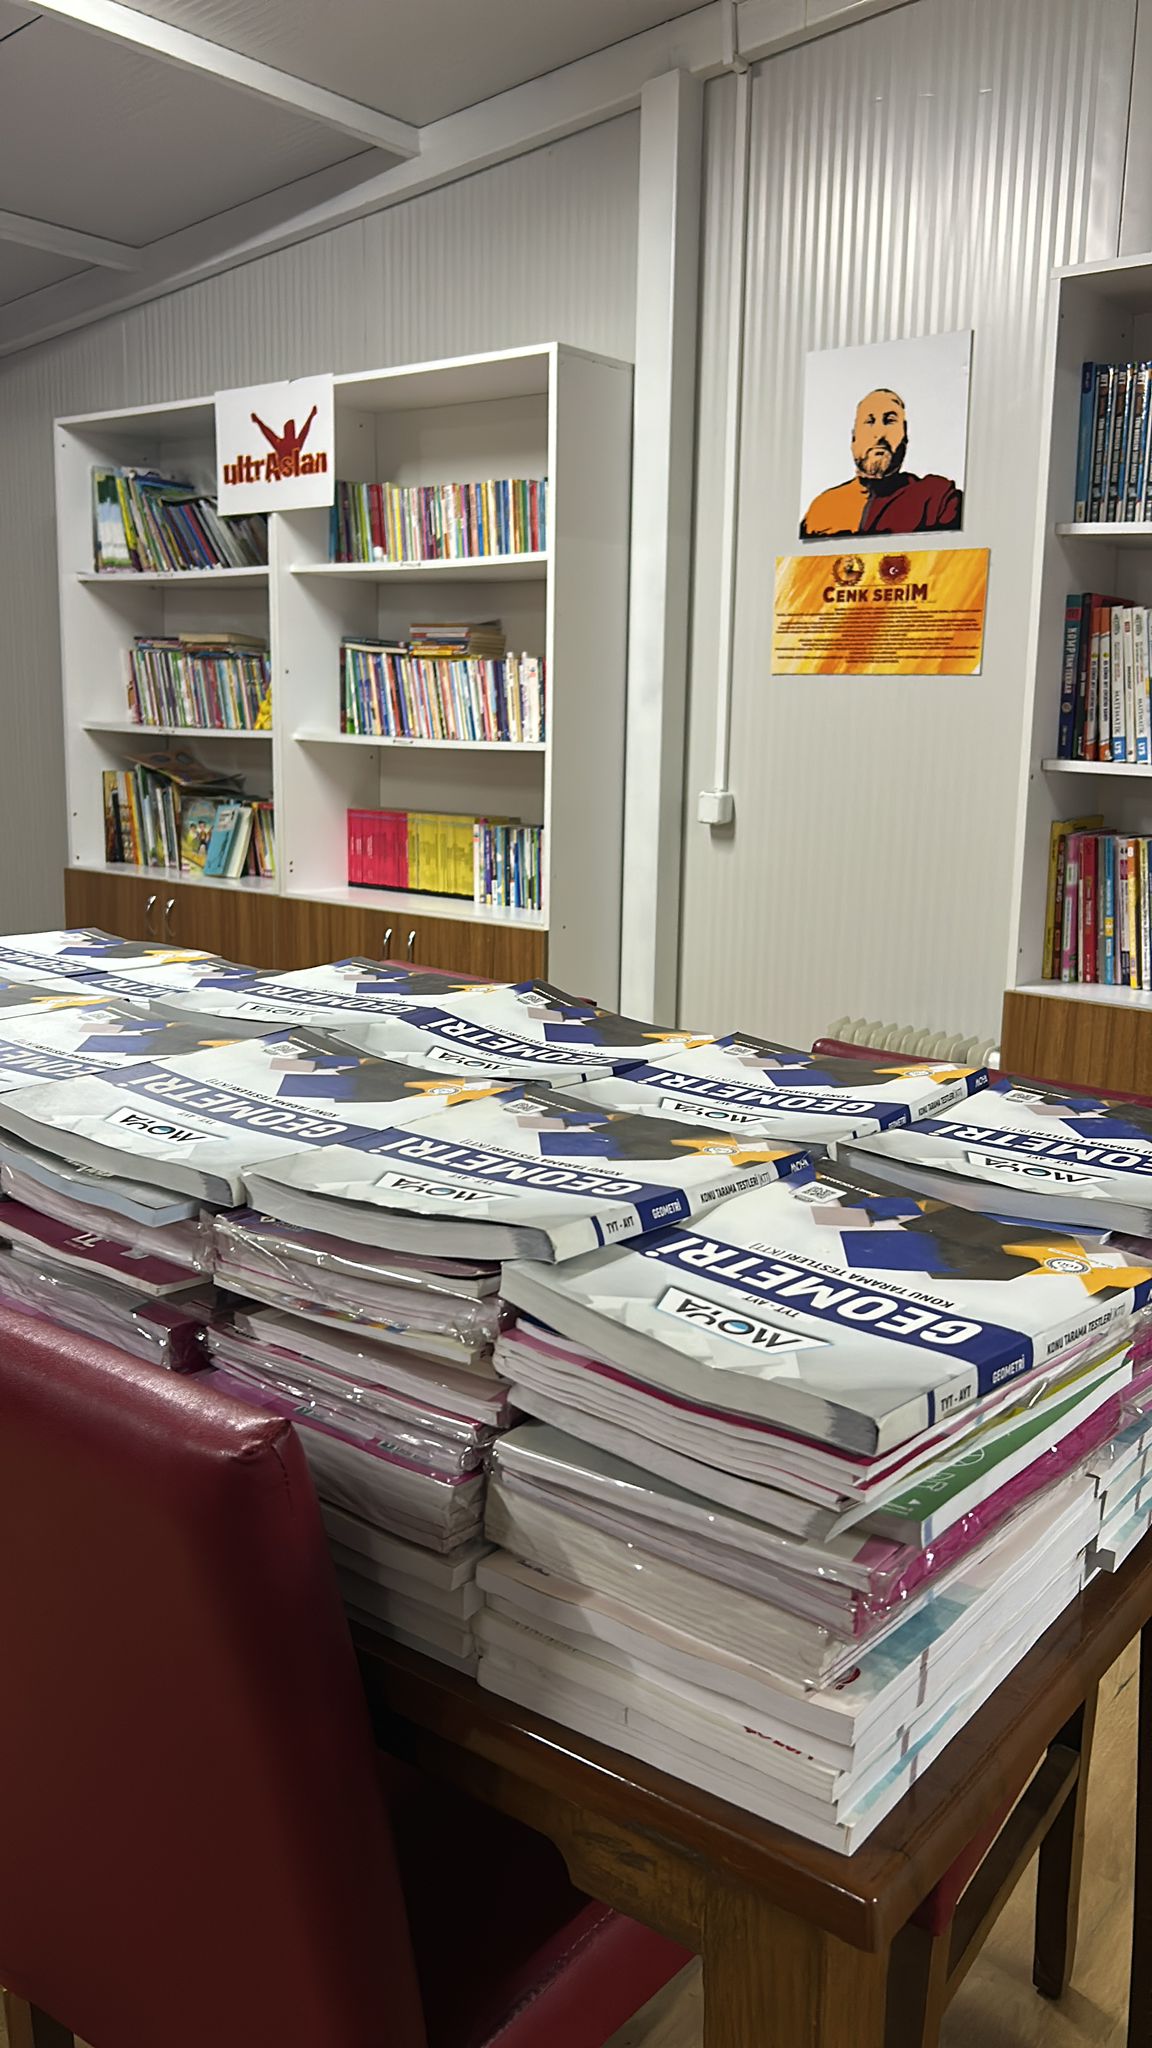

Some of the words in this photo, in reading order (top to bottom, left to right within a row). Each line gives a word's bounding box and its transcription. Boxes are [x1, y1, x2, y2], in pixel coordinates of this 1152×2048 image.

[223, 448, 327, 485] ultrAslan
[822, 586, 868, 603] CENK
[419, 1017, 619, 1065] GEOMETRİ
[115, 1073, 349, 1138] GEOMETRİ
[637, 1072, 876, 1114] GEOMETRİ
[673, 1103, 764, 1123] MOYA
[119, 1114, 206, 1141] MOYA
[368, 1136, 643, 1196] GEOMETRİ
[985, 1157, 1090, 1183] MOYA
[390, 1177, 496, 1200] MOYA
[606, 1220, 617, 1234] TYT
[623, 1216, 635, 1229] AYT
[643, 1236, 983, 1344] GEOMETRİ
[849, 1273, 904, 1295] TARAMA
[743, 1295, 769, 1306] AYT
[775, 1306, 800, 1318] TYT
[906, 1292, 956, 1308] KONU
[676, 1298, 803, 1349] MOYA
[992, 1353, 1025, 1384] GEOMETRİ
[941, 1397, 953, 1412] TYT
[959, 1385, 972, 1402] AYT
